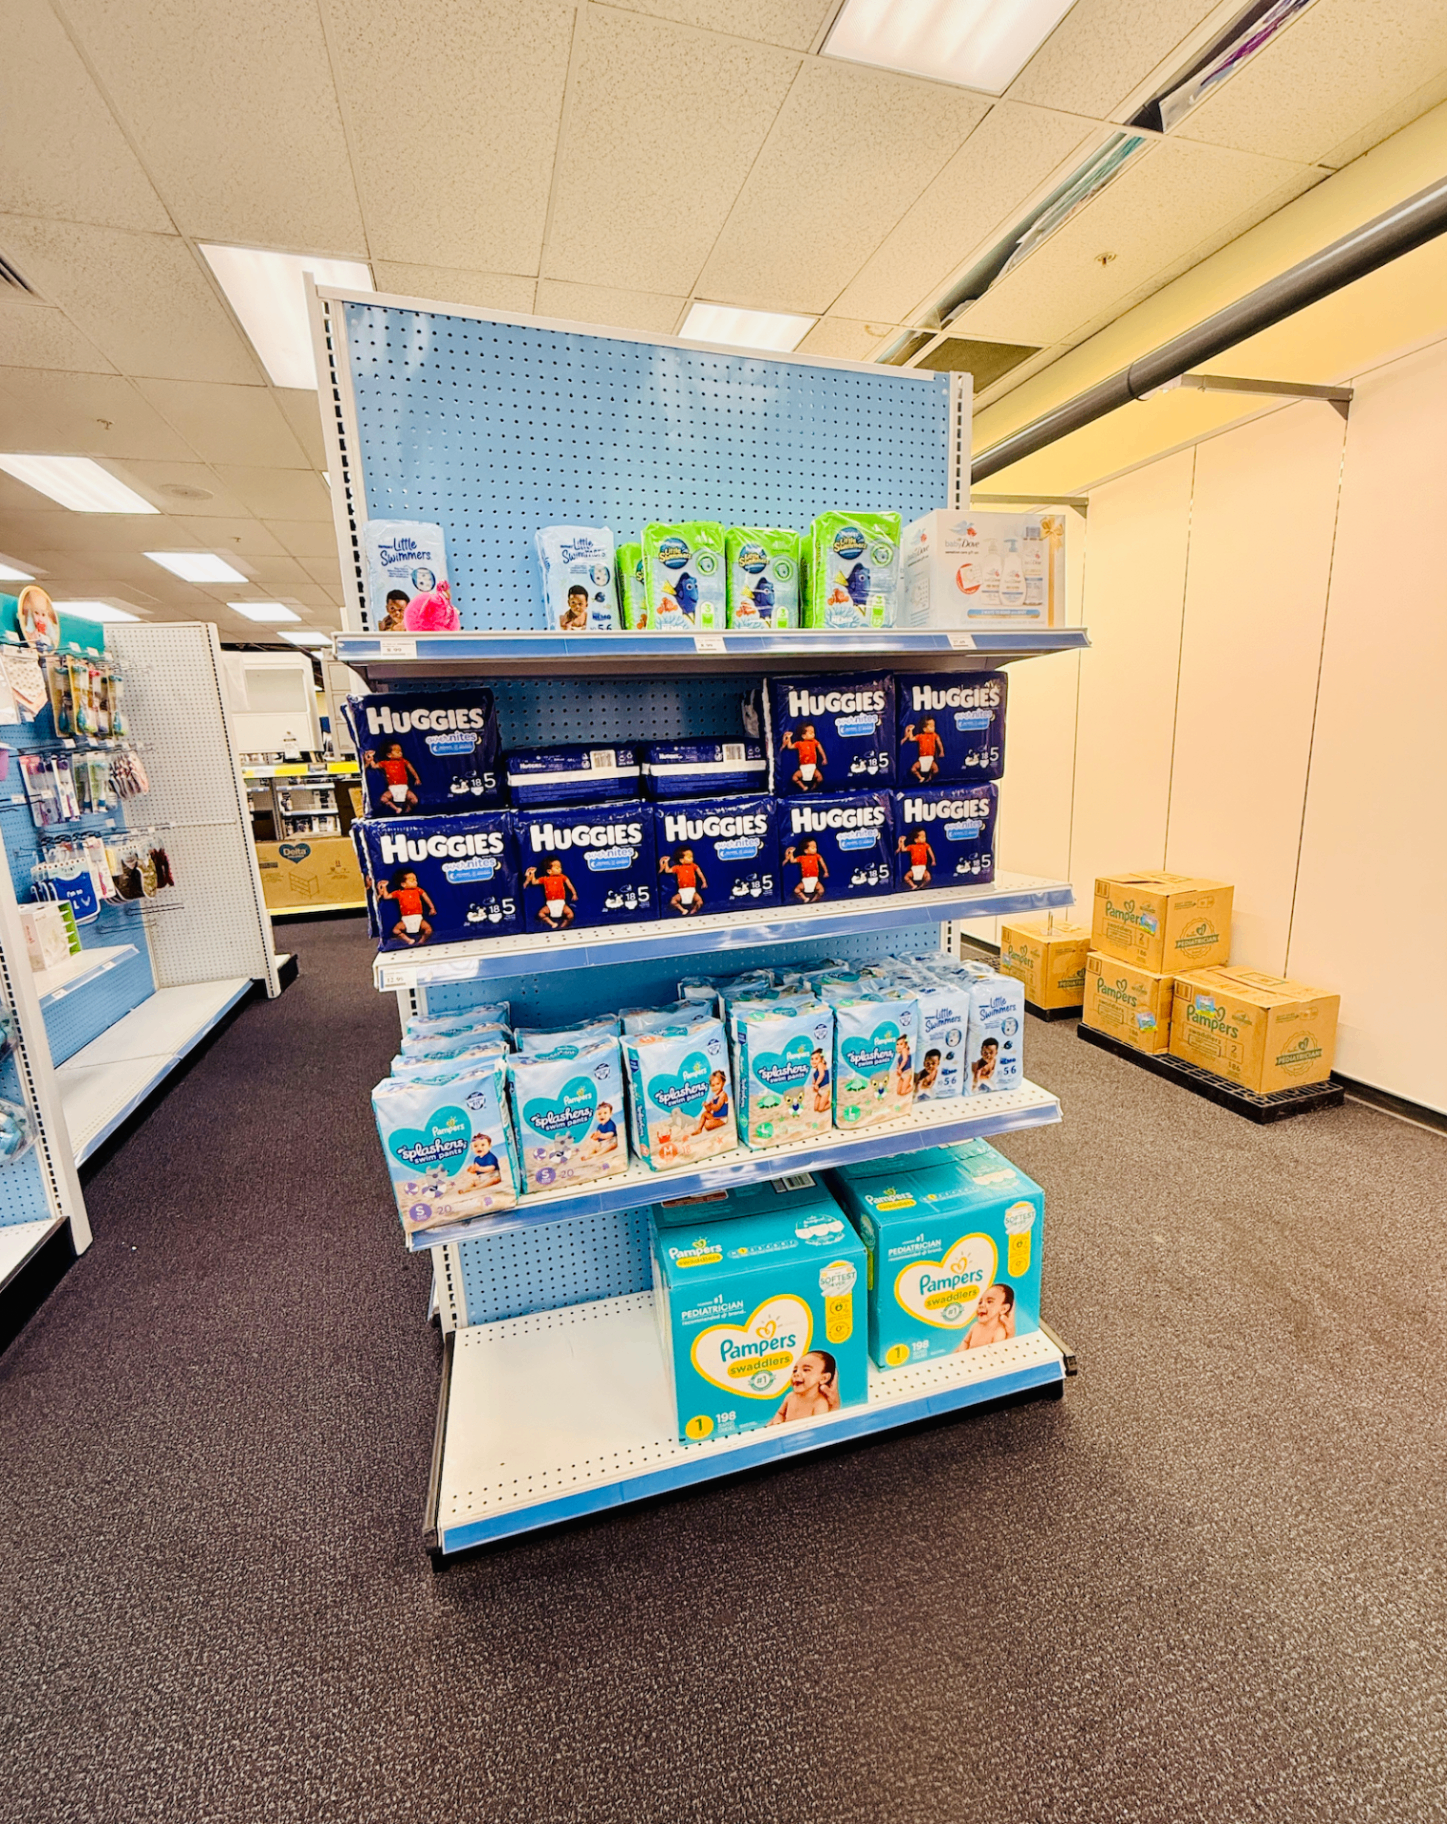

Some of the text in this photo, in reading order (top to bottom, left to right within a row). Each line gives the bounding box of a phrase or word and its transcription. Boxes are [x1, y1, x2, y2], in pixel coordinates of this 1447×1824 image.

[394, 537, 417, 551] Little
[573, 537, 594, 550] Little
[961, 539, 980, 548] Dove
[380, 549, 431, 566] Swimmers
[789, 690, 885, 717] HUGGIES
[912, 685, 1000, 711] HUGGIES
[366, 706, 484, 735] HUGGIES
[869, 752, 889, 768] 18 5
[989, 747, 999, 762] 5
[471, 772, 496, 788] 18 5
[904, 798, 990, 823] HUGGIES
[791, 806, 886, 834] HUGGIES
[665, 814, 768, 842] HUGGIES
[530, 823, 642, 852] HUGGIES
[282, 847, 307, 856] Delta
[380, 832, 504, 864] HUGGIES
[981, 854, 991, 868] 5
[868, 864, 890, 879] 18 5
[762, 874, 773, 890] 5
[625, 886, 650, 902] 18 5
[489, 898, 516, 915] 18 5
[1105, 900, 1142, 926] Pamper
[1177, 934, 1219, 947] PEDIATRICIAN
[1097, 977, 1137, 1007] Pampers
[990, 996, 1007, 1009] Little
[936, 1008, 952, 1020] Little
[980, 1004, 1016, 1021] Swimmers
[925, 1016, 961, 1033] Swimmers
[1186, 1004, 1239, 1039] Pampers
[850, 1048, 894, 1065] splashers
[1231, 1045, 1237, 1054] 2
[1278, 1050, 1322, 1065] PEDIATRICIAN
[682, 1068, 707, 1080] Pampers
[762, 1062, 808, 1082] splashers
[1003, 1065, 1017, 1076] 5 6
[1228, 1061, 1241, 1072] 186
[944, 1076, 957, 1085] 5 6
[563, 1092, 592, 1105] Pampers
[659, 1082, 707, 1104] splashers
[668, 1097, 685, 1106] swim
[535, 1106, 590, 1128] splashers
[546, 1117, 588, 1131] swim pants
[432, 1124, 465, 1136] Pampers
[761, 1124, 769, 1134] L
[402, 1138, 464, 1161] splashers
[415, 1149, 462, 1164] swim pants
[663, 1146, 673, 1156] M
[682, 1145, 692, 1154] 18
[542, 1169, 549, 1179] S
[561, 1168, 574, 1178] 20
[865, 1192, 913, 1205] Pampers
[415, 1206, 425, 1216] S
[437, 1204, 452, 1215] 20
[669, 1244, 722, 1260] Pampers
[888, 1239, 942, 1256] PEDIATRICIAN
[820, 1271, 856, 1285] SOFTEST
[919, 1269, 984, 1295] Pampers
[714, 1294, 723, 1304] #1
[927, 1289, 977, 1307] swaddlers
[681, 1300, 744, 1319] PEDIATRICIAN
[947, 1307, 957, 1316] #1
[720, 1334, 796, 1362] Pampers
[894, 1339, 930, 1358] 1 198
[730, 1355, 790, 1375] swaddlers
[757, 1375, 767, 1384] #1
[695, 1410, 736, 1431] 1 198
